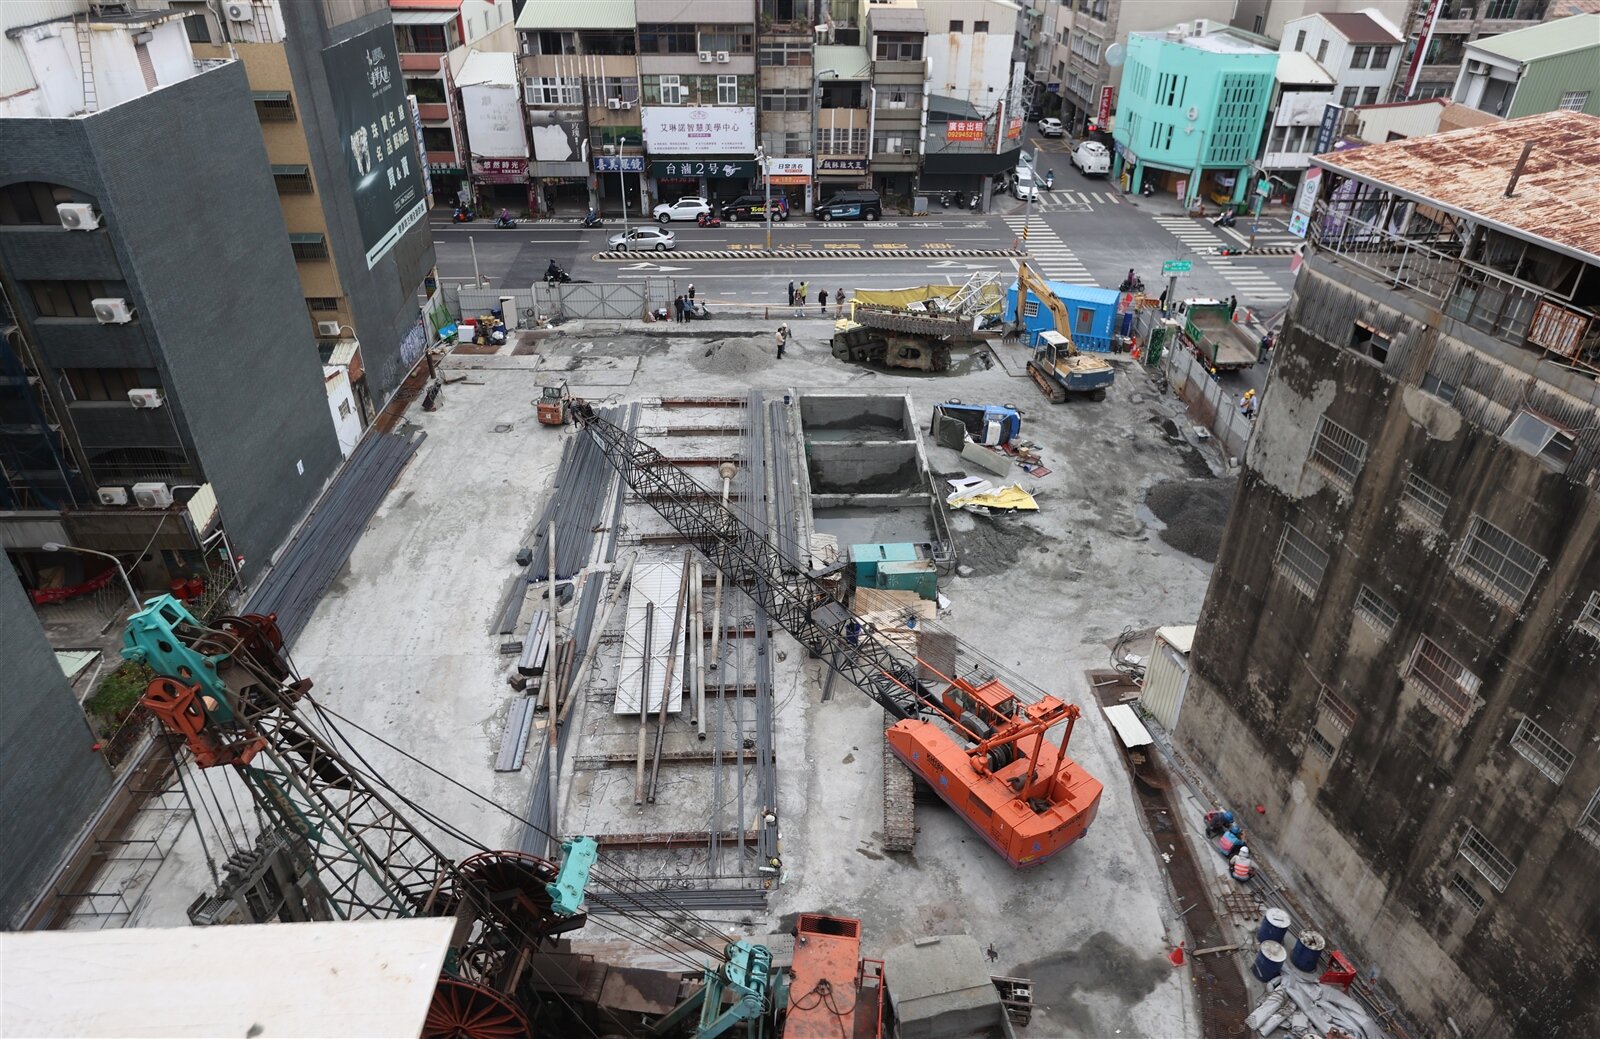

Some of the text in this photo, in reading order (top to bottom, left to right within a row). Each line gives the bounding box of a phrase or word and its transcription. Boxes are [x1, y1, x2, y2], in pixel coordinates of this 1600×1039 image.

[661, 123, 739, 132] 艾琳諾智慧美學中心
[948, 122, 983, 131] 廣告出租
[376, 127, 410, 162] 名品藝術品
[484, 161, 518, 169] 悠然時光
[387, 155, 410, 190] 買&賣
